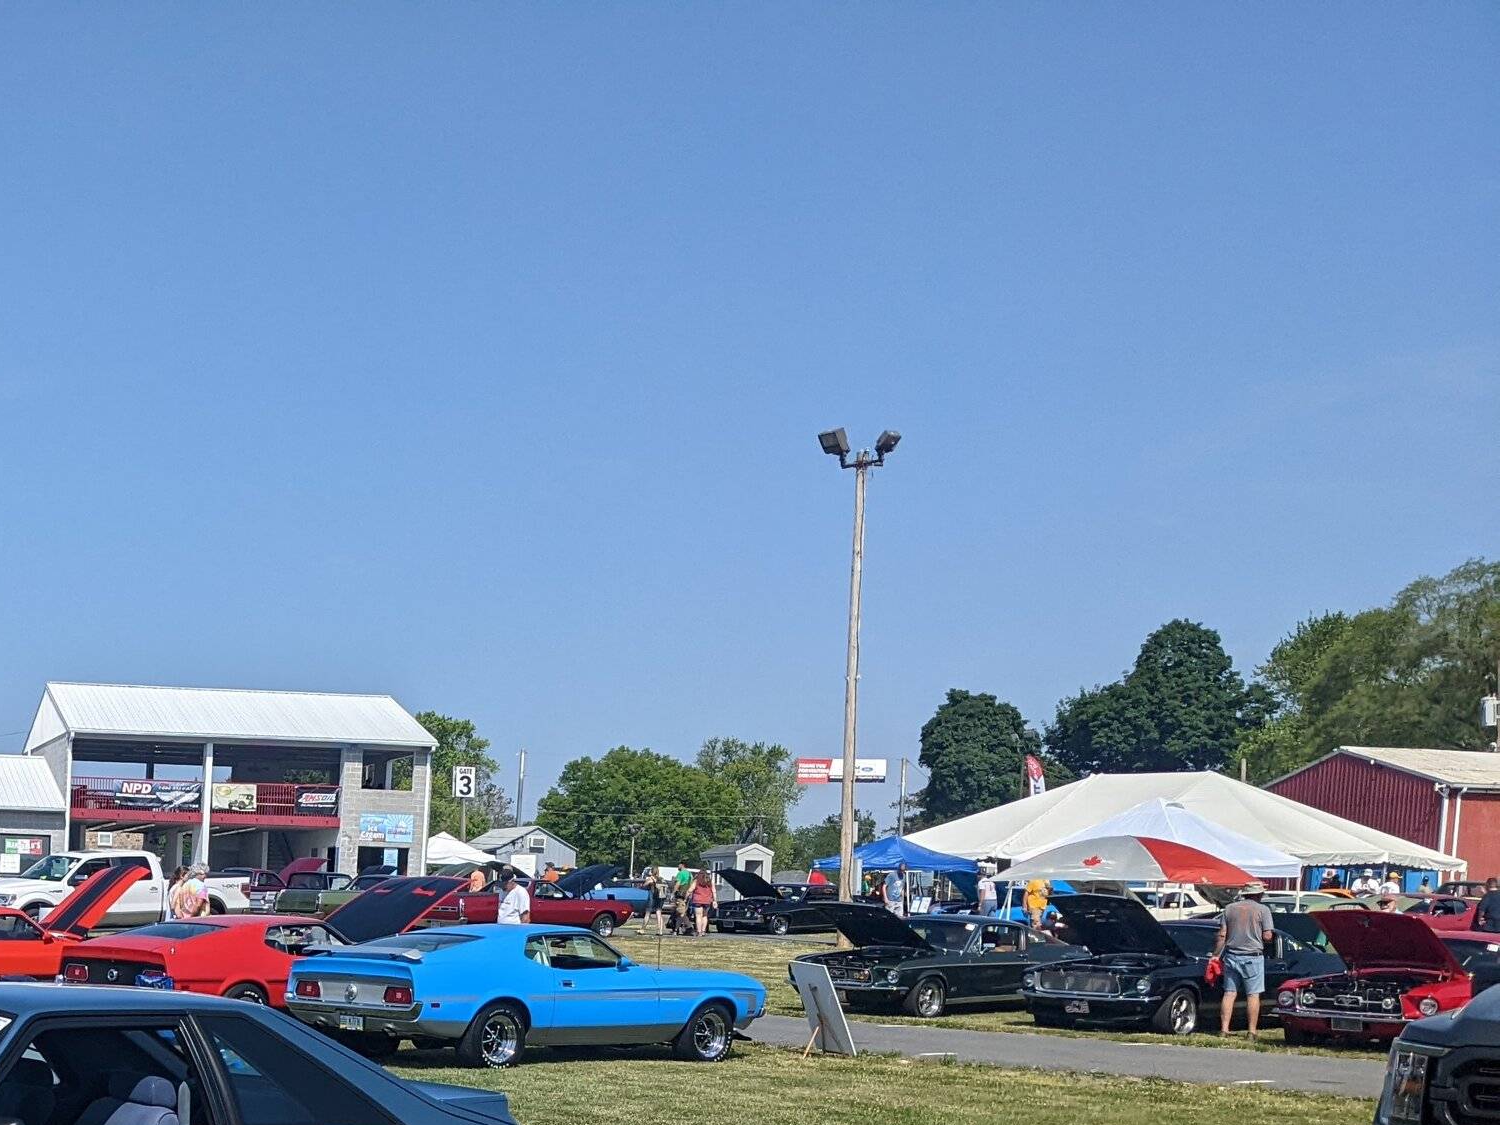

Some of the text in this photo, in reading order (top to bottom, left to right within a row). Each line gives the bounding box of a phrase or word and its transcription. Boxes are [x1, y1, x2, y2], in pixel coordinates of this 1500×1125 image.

[122, 782, 153, 794] NPD
[459, 775, 472, 796] 3
[300, 794, 336, 803] AMSOIL
